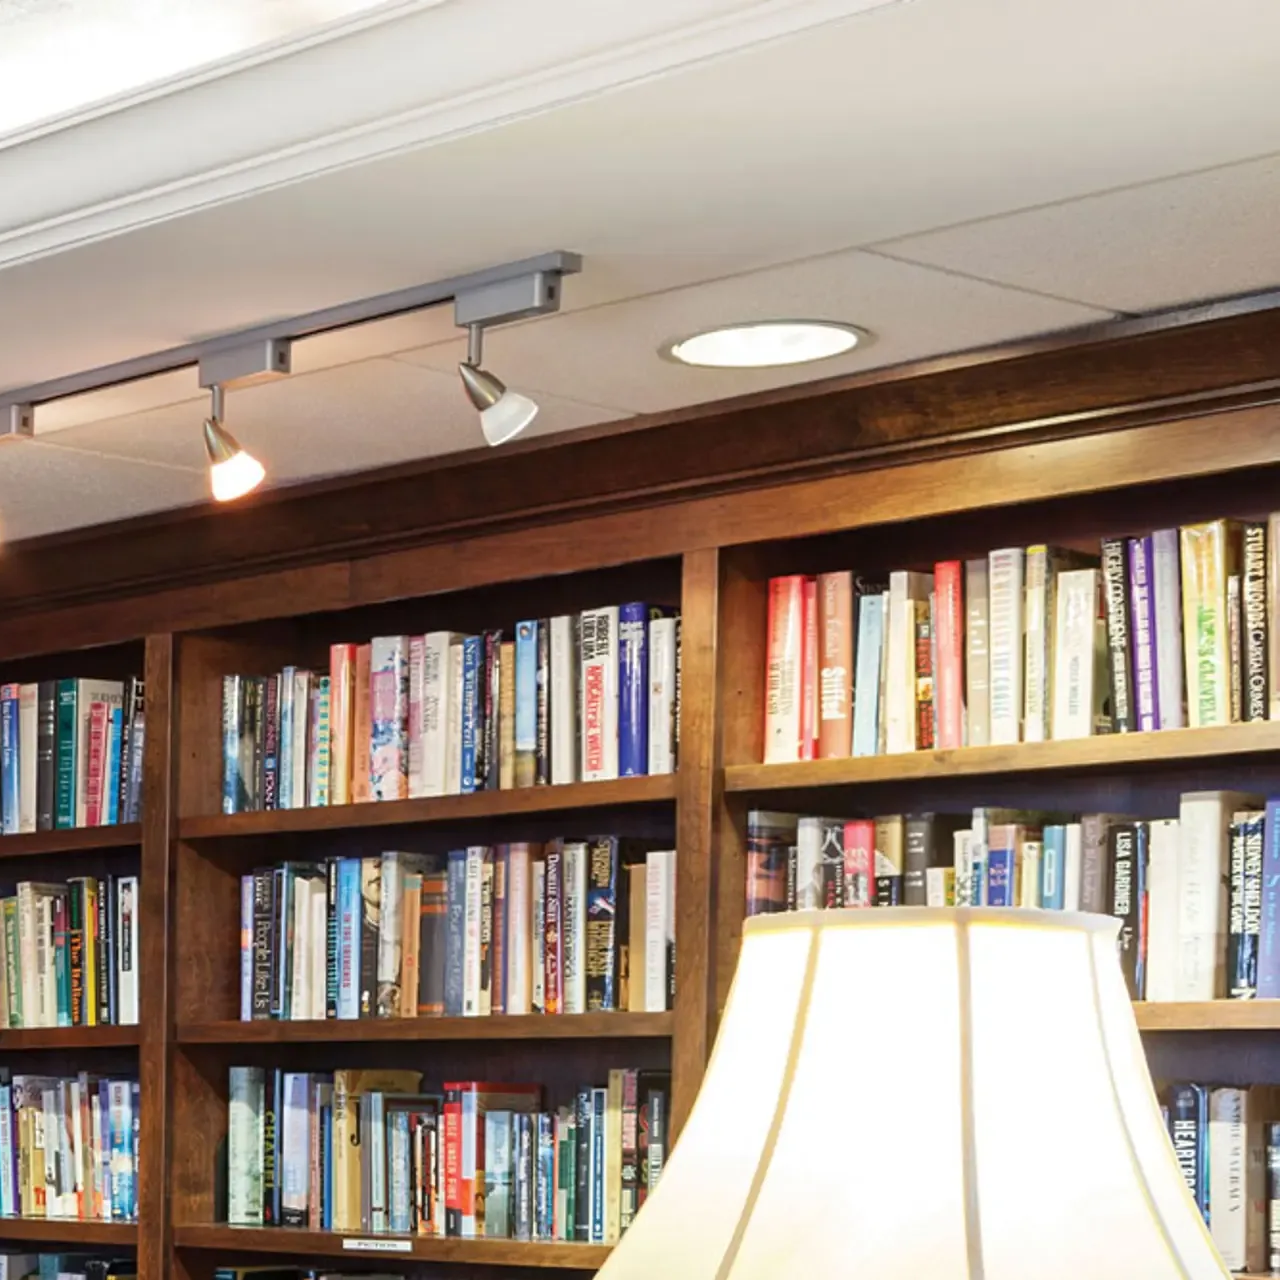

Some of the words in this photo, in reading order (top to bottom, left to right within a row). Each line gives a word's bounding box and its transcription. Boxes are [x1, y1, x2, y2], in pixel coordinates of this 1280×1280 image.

[1245, 528, 1264, 576] STUART
[1245, 578, 1264, 628] WOODS
[1115, 832, 1133, 858] LISA
[1114, 861, 1132, 914] GARDNER
[72, 965, 82, 1022] Italians
